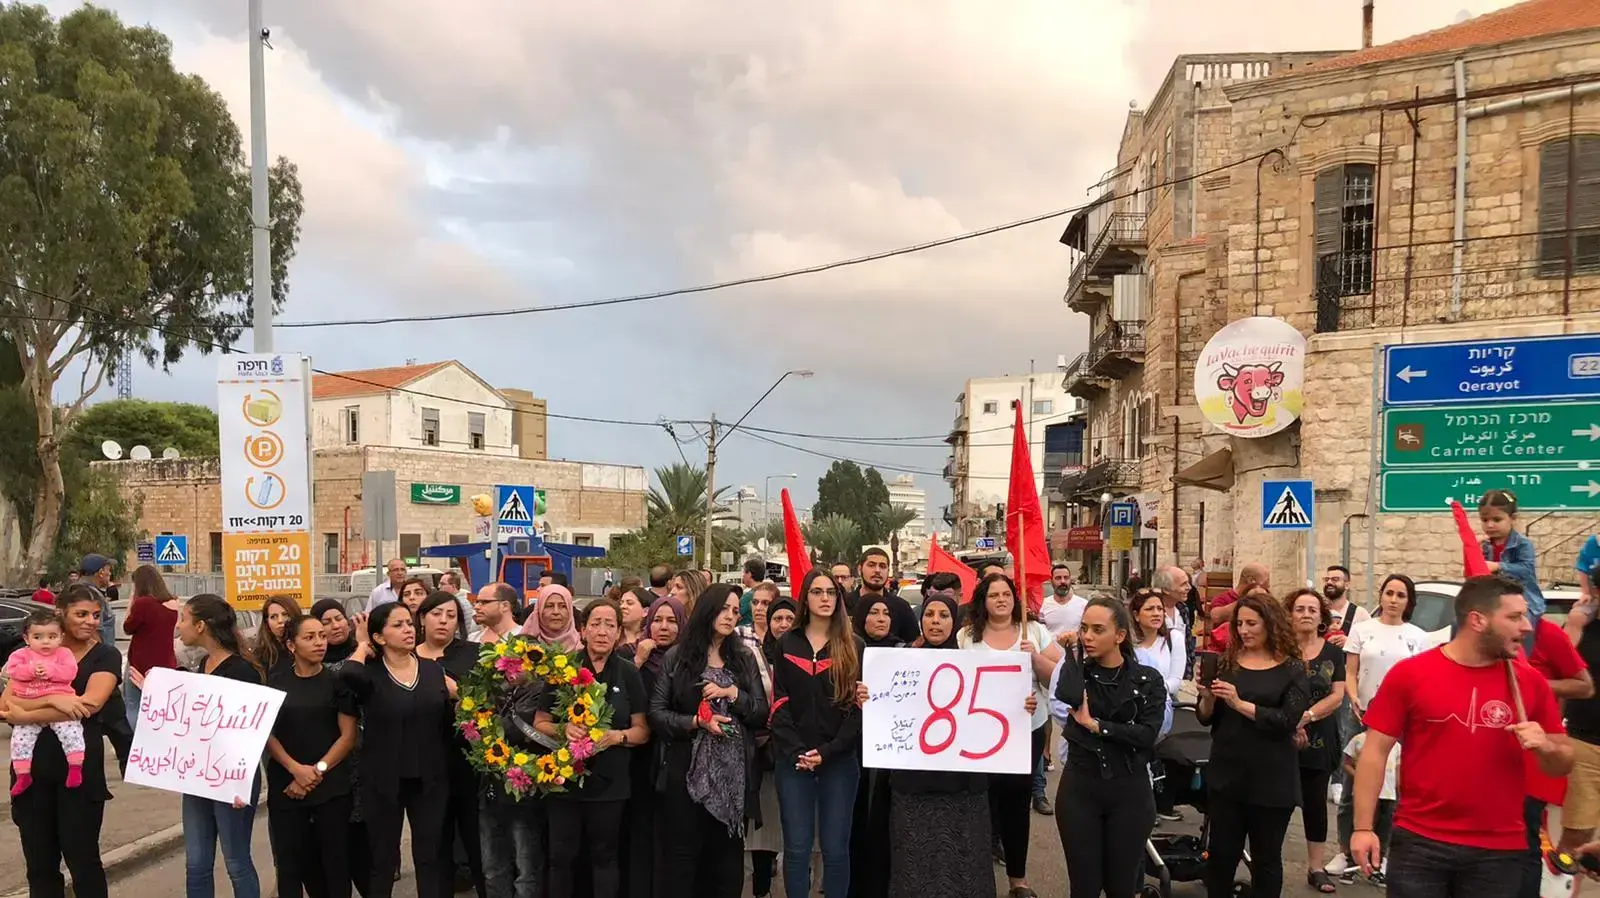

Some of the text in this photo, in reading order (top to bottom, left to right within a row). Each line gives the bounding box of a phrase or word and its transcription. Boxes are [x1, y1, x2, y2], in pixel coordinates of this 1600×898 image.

[1468, 346, 1516, 359] קריות
[237, 360, 267, 371] חיפה
[1469, 361, 1513, 377] كريوت
[1459, 380, 1520, 393] Qerayot
[1444, 412, 1552, 426] מרכז הכרמל
[1457, 429, 1536, 444] مركز الكرمل
[1431, 444, 1565, 457] Carmel Center
[1451, 476, 1482, 488] هدار
[1506, 474, 1541, 485] הדר
[289, 515, 303, 525] 20
[235, 544, 300, 564] 20 דקות
[235, 563, 300, 577] חניה חינם
[192, 694, 269, 741] الشرطة
[919, 662, 1022, 760] 85
[129, 747, 177, 775] الجريمة
[177, 752, 197, 779] في
